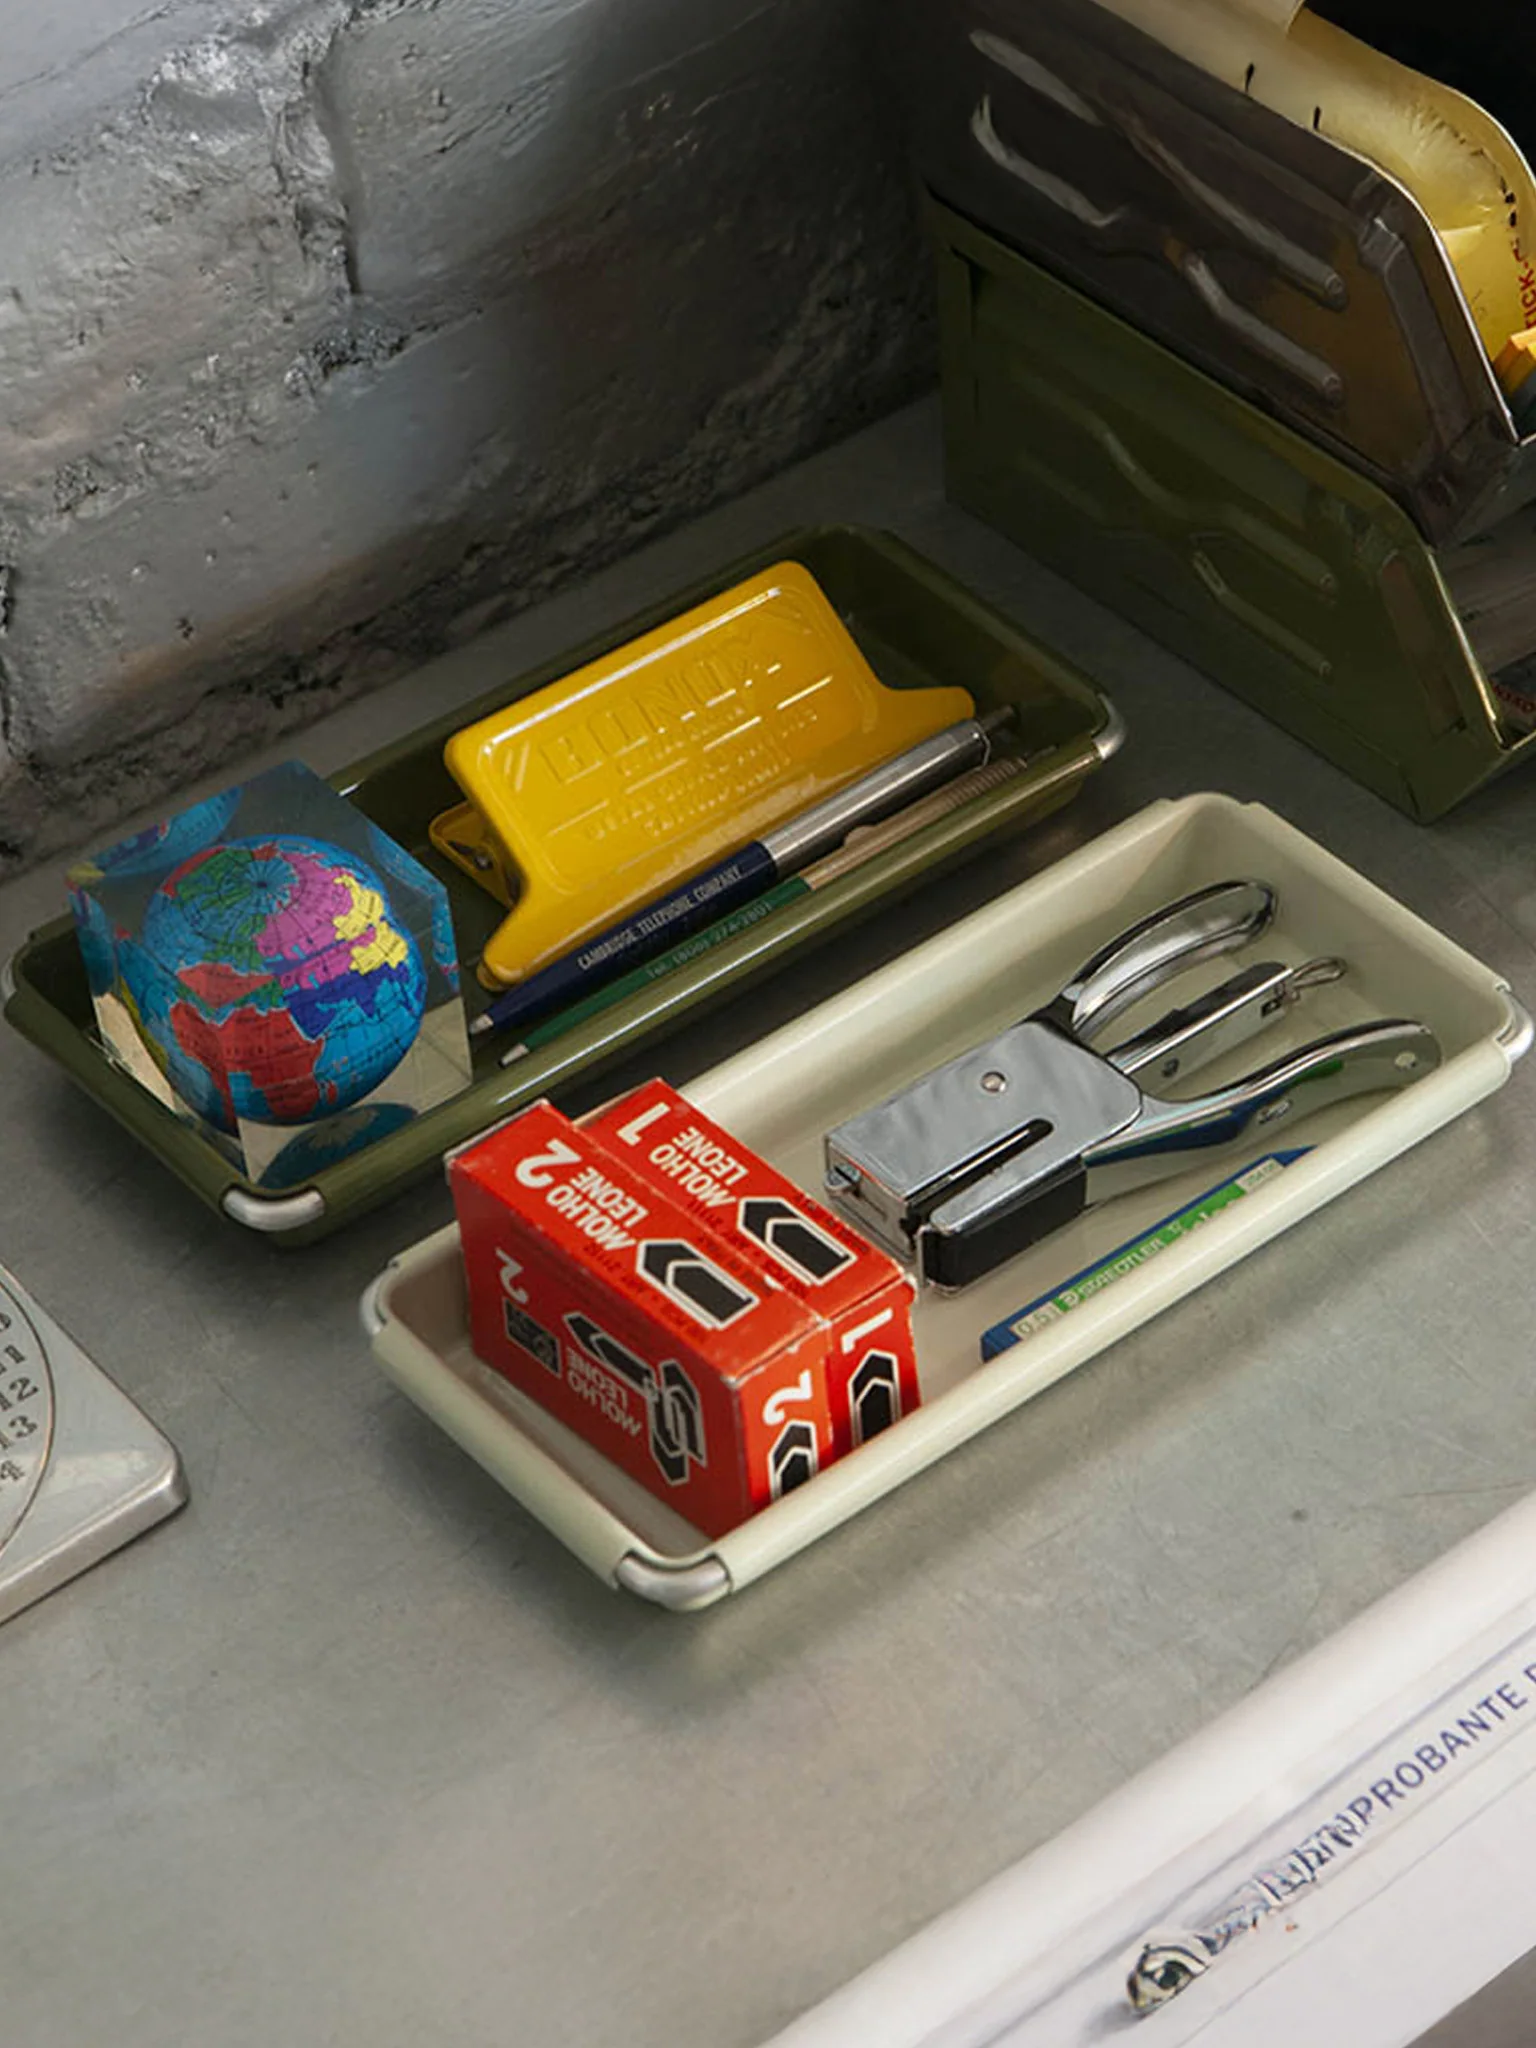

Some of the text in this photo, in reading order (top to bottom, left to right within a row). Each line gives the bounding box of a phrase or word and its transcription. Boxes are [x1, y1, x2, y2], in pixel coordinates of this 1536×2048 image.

[637, 894, 695, 935] TELEPHONE
[693, 865, 744, 903] COMPANY
[616, 1102, 671, 1145] 1
[515, 1138, 581, 1186] 2
[649, 1144, 737, 1208] MOLHO
[672, 1126, 749, 1186] LEONE
[546, 1184, 637, 1252] MOLHO
[581, 1166, 649, 1228] LEONE
[494, 1247, 529, 1303] 2
[841, 1308, 893, 1354] 1
[567, 1346, 630, 1407] LEONE
[567, 1371, 643, 1438] MOLHO
[762, 1370, 813, 1426] 2
